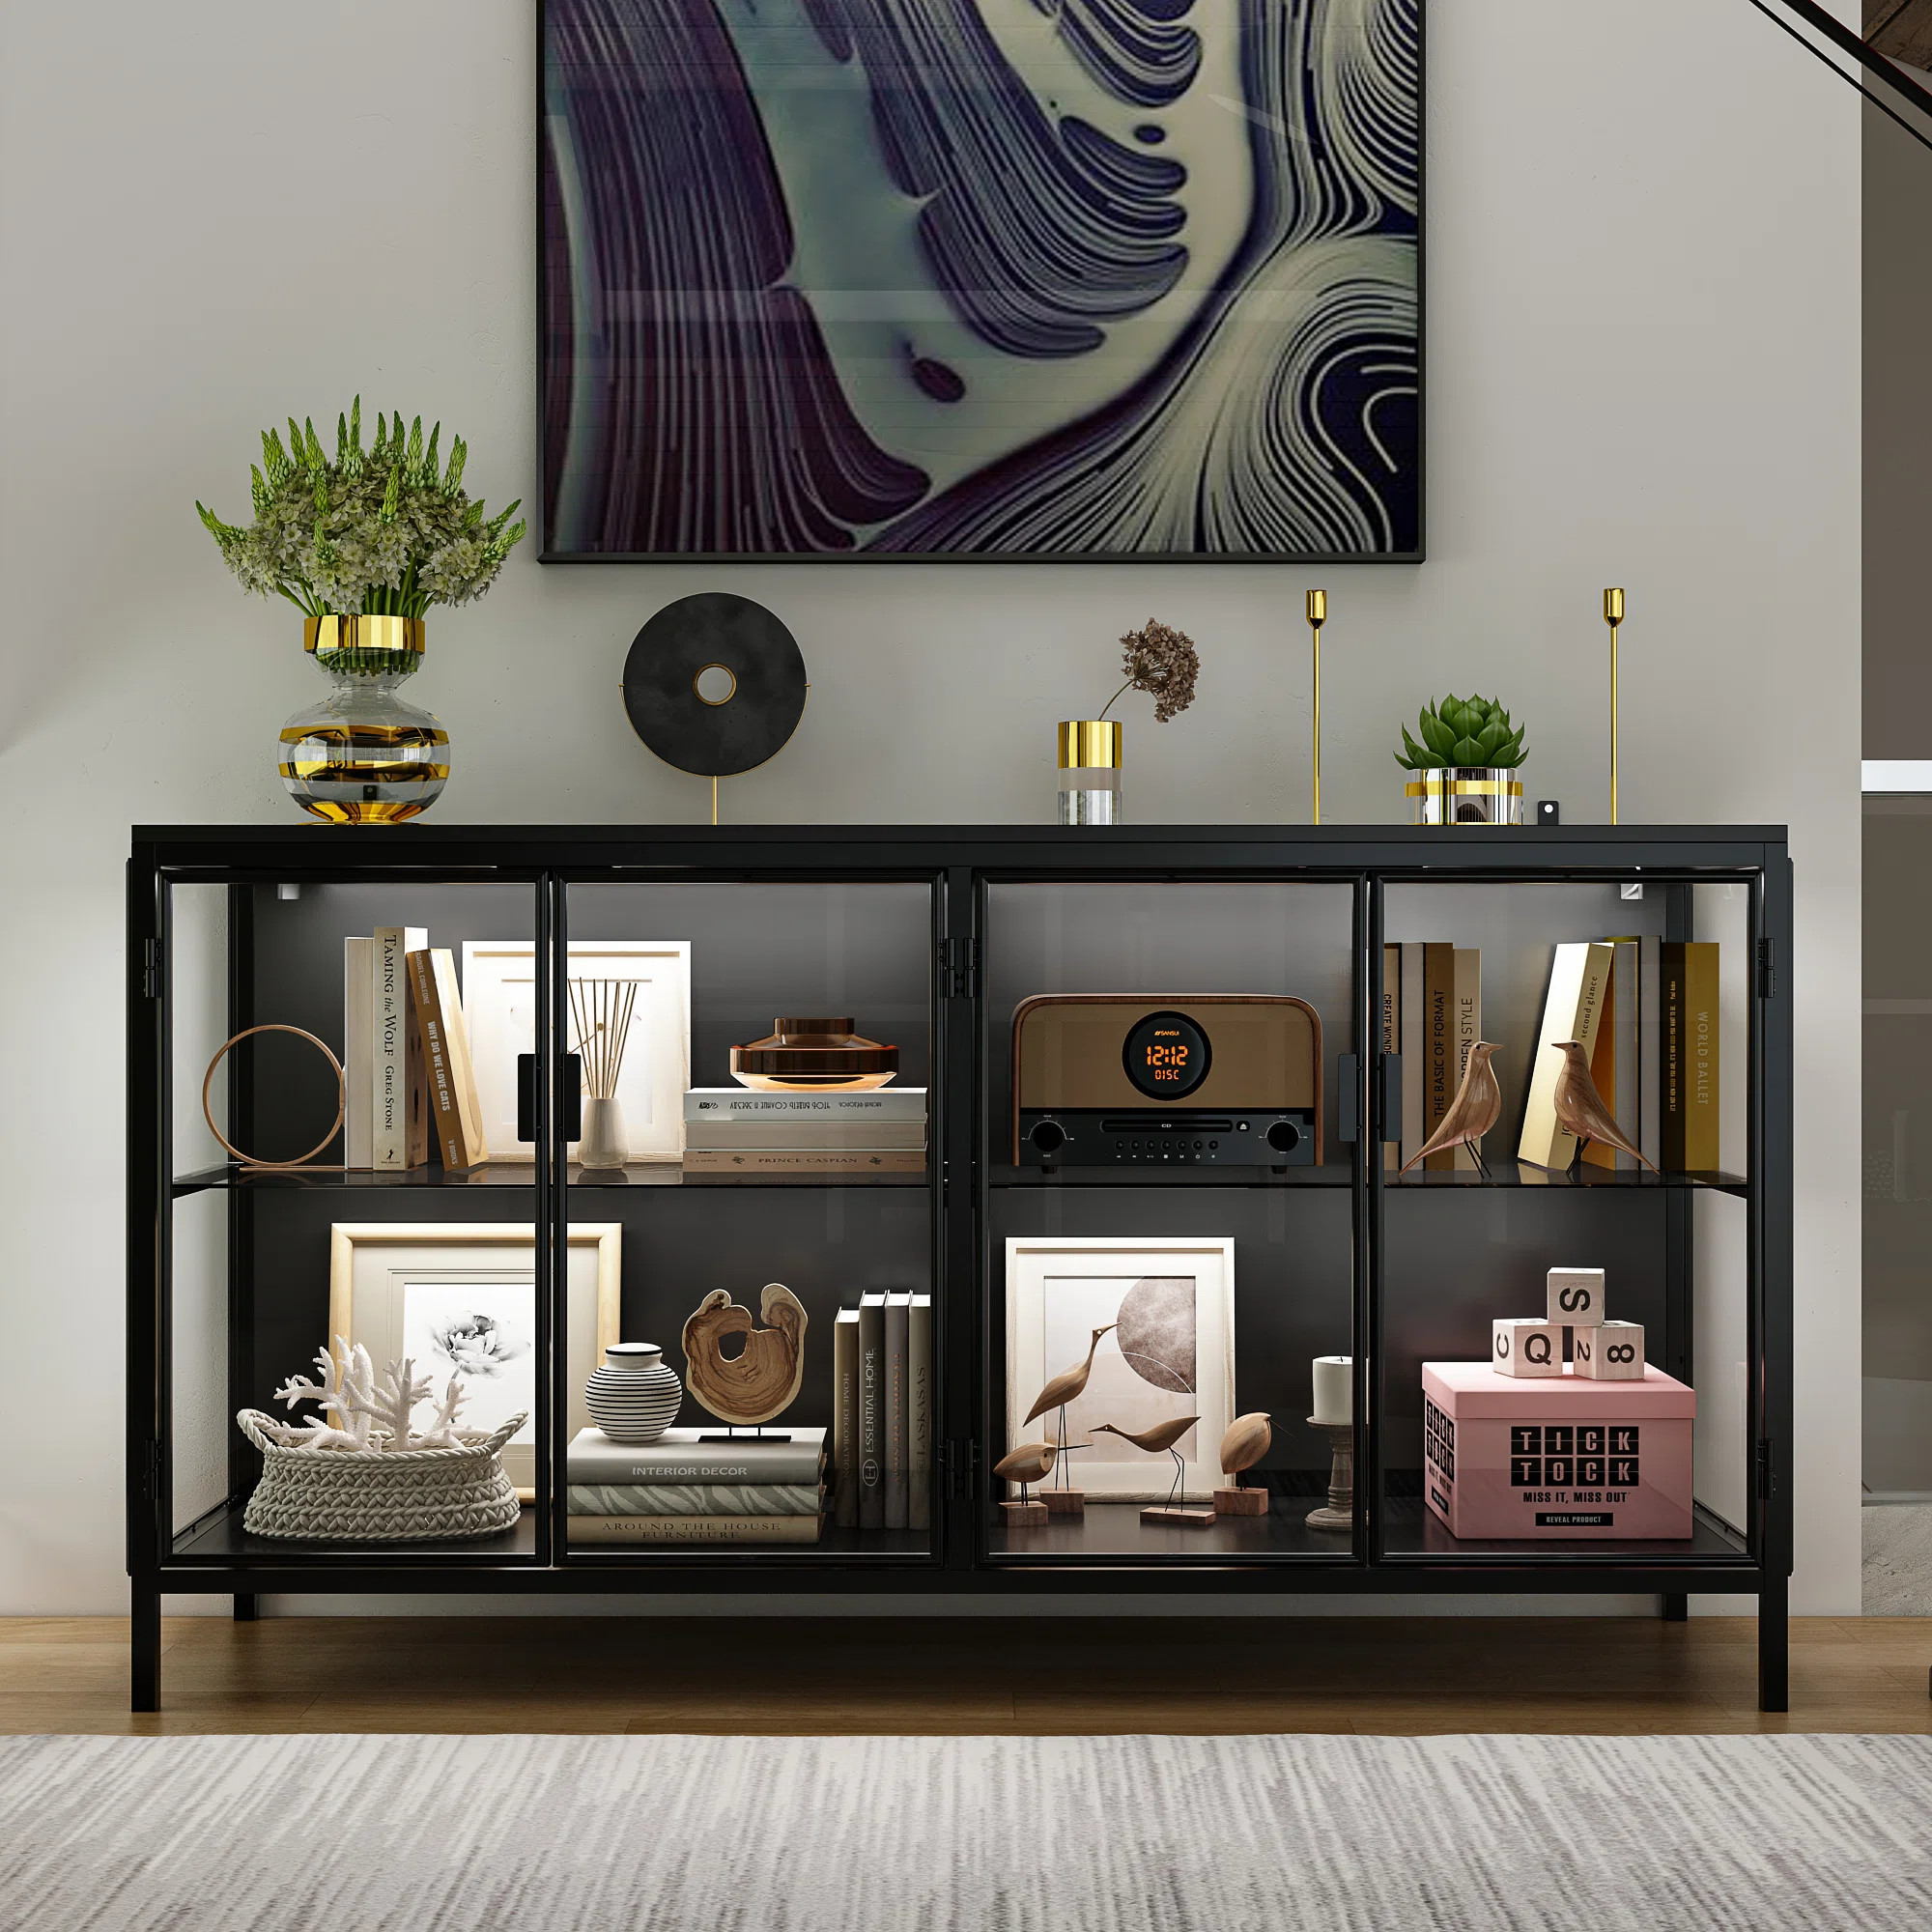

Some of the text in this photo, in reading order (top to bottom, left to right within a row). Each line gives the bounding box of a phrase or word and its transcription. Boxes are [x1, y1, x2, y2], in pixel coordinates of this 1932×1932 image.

[384, 934, 397, 1056] TAMING the WOLF
[1383, 993, 1392, 1024] CREATE
[1579, 975, 1598, 1039] second glance
[1461, 998, 1472, 1035] STYLE
[427, 1021, 451, 1111] WHY DO WE LOVE CATS
[1147, 1045, 1188, 1065] 12:12
[1434, 989, 1444, 1118] THE BASIC OF FORMAT
[1697, 1011, 1709, 1105] WORLD BALLET
[384, 1065, 394, 1131] GREG STONE
[449, 1145, 459, 1165] BOOKS
[1558, 1287, 1590, 1312] S
[1524, 1333, 1552, 1365] Q
[1606, 1344, 1635, 1363] 8
[865, 1349, 874, 1453] ESSENTIAL HOME
[916, 1366, 925, 1457] LASKASAS
[1520, 1431, 1631, 1452] TICK
[632, 1466, 748, 1476] INTERIOR DECOR
[1520, 1462, 1631, 1482] TOCK
[1522, 1492, 1551, 1503] MISS
[1555, 1492, 1569, 1504] IT,
[1573, 1492, 1602, 1503] MISS
